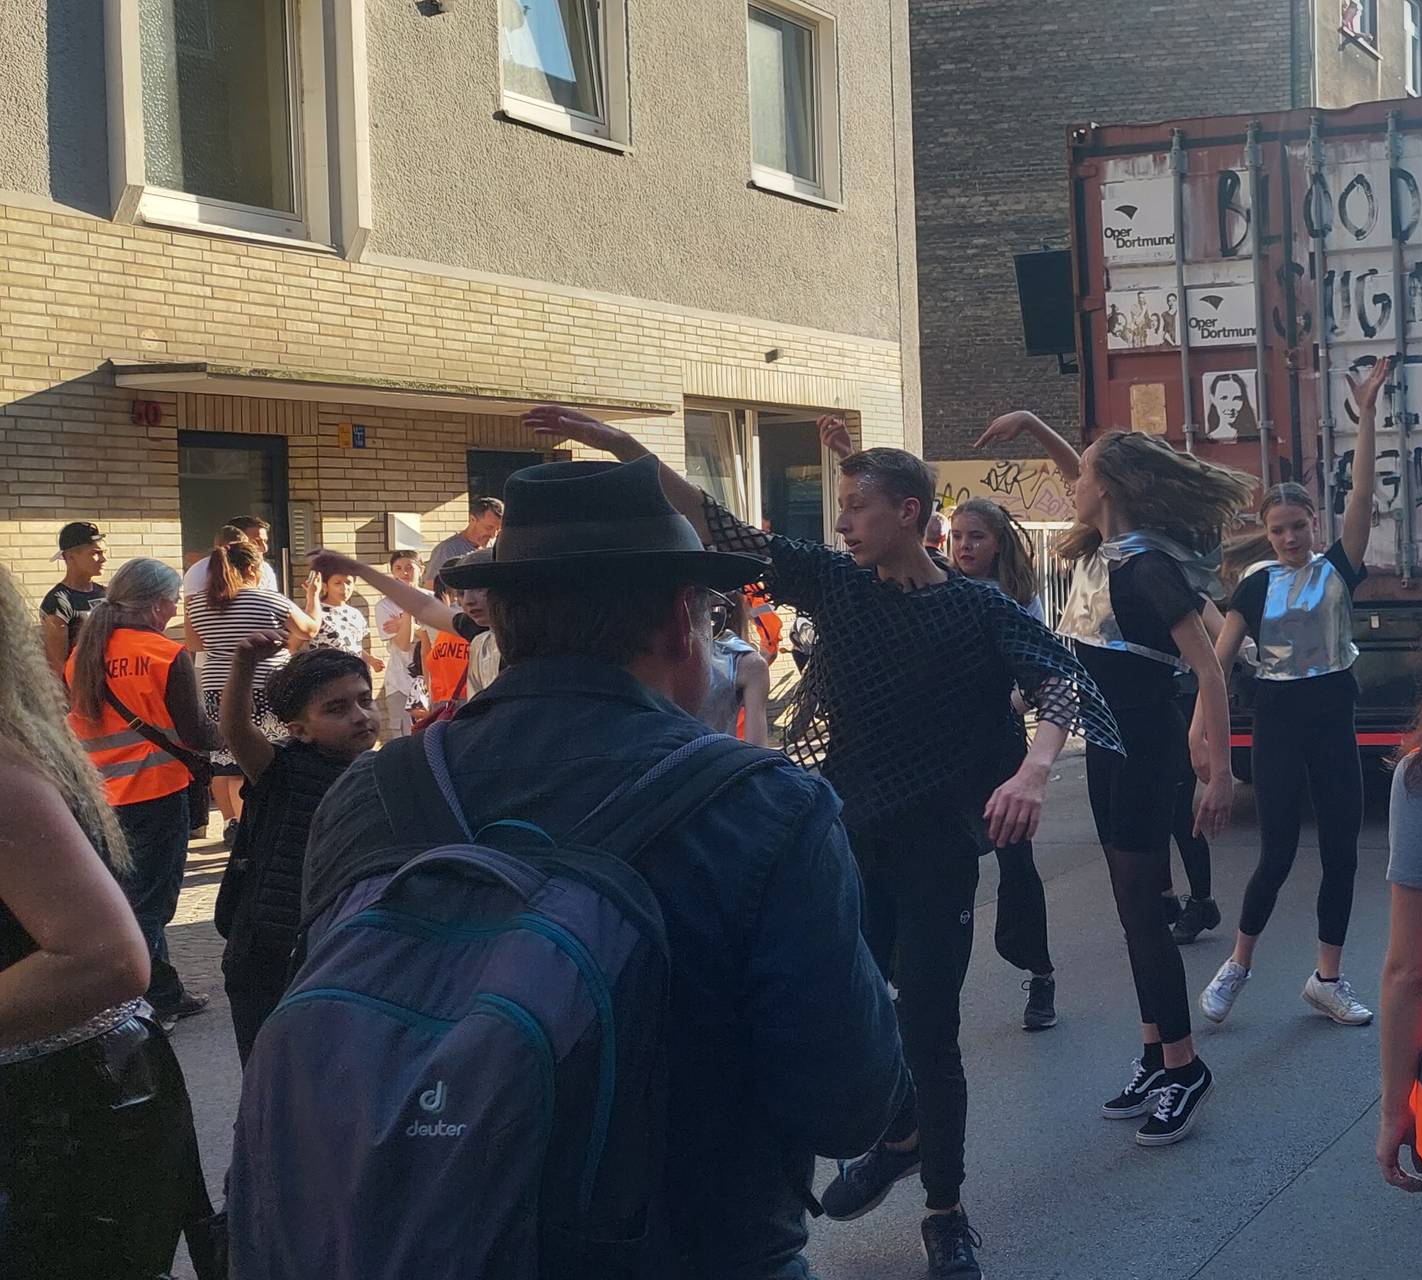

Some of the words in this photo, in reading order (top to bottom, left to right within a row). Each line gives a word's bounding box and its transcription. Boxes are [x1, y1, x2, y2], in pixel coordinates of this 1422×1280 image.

[1217, 168, 1421, 258] BLOOD
[1104, 227, 1132, 240] Oper
[1116, 233, 1176, 249] Dortmund
[1188, 317, 1218, 331] Oper
[406, 1119, 467, 1137] deuter
